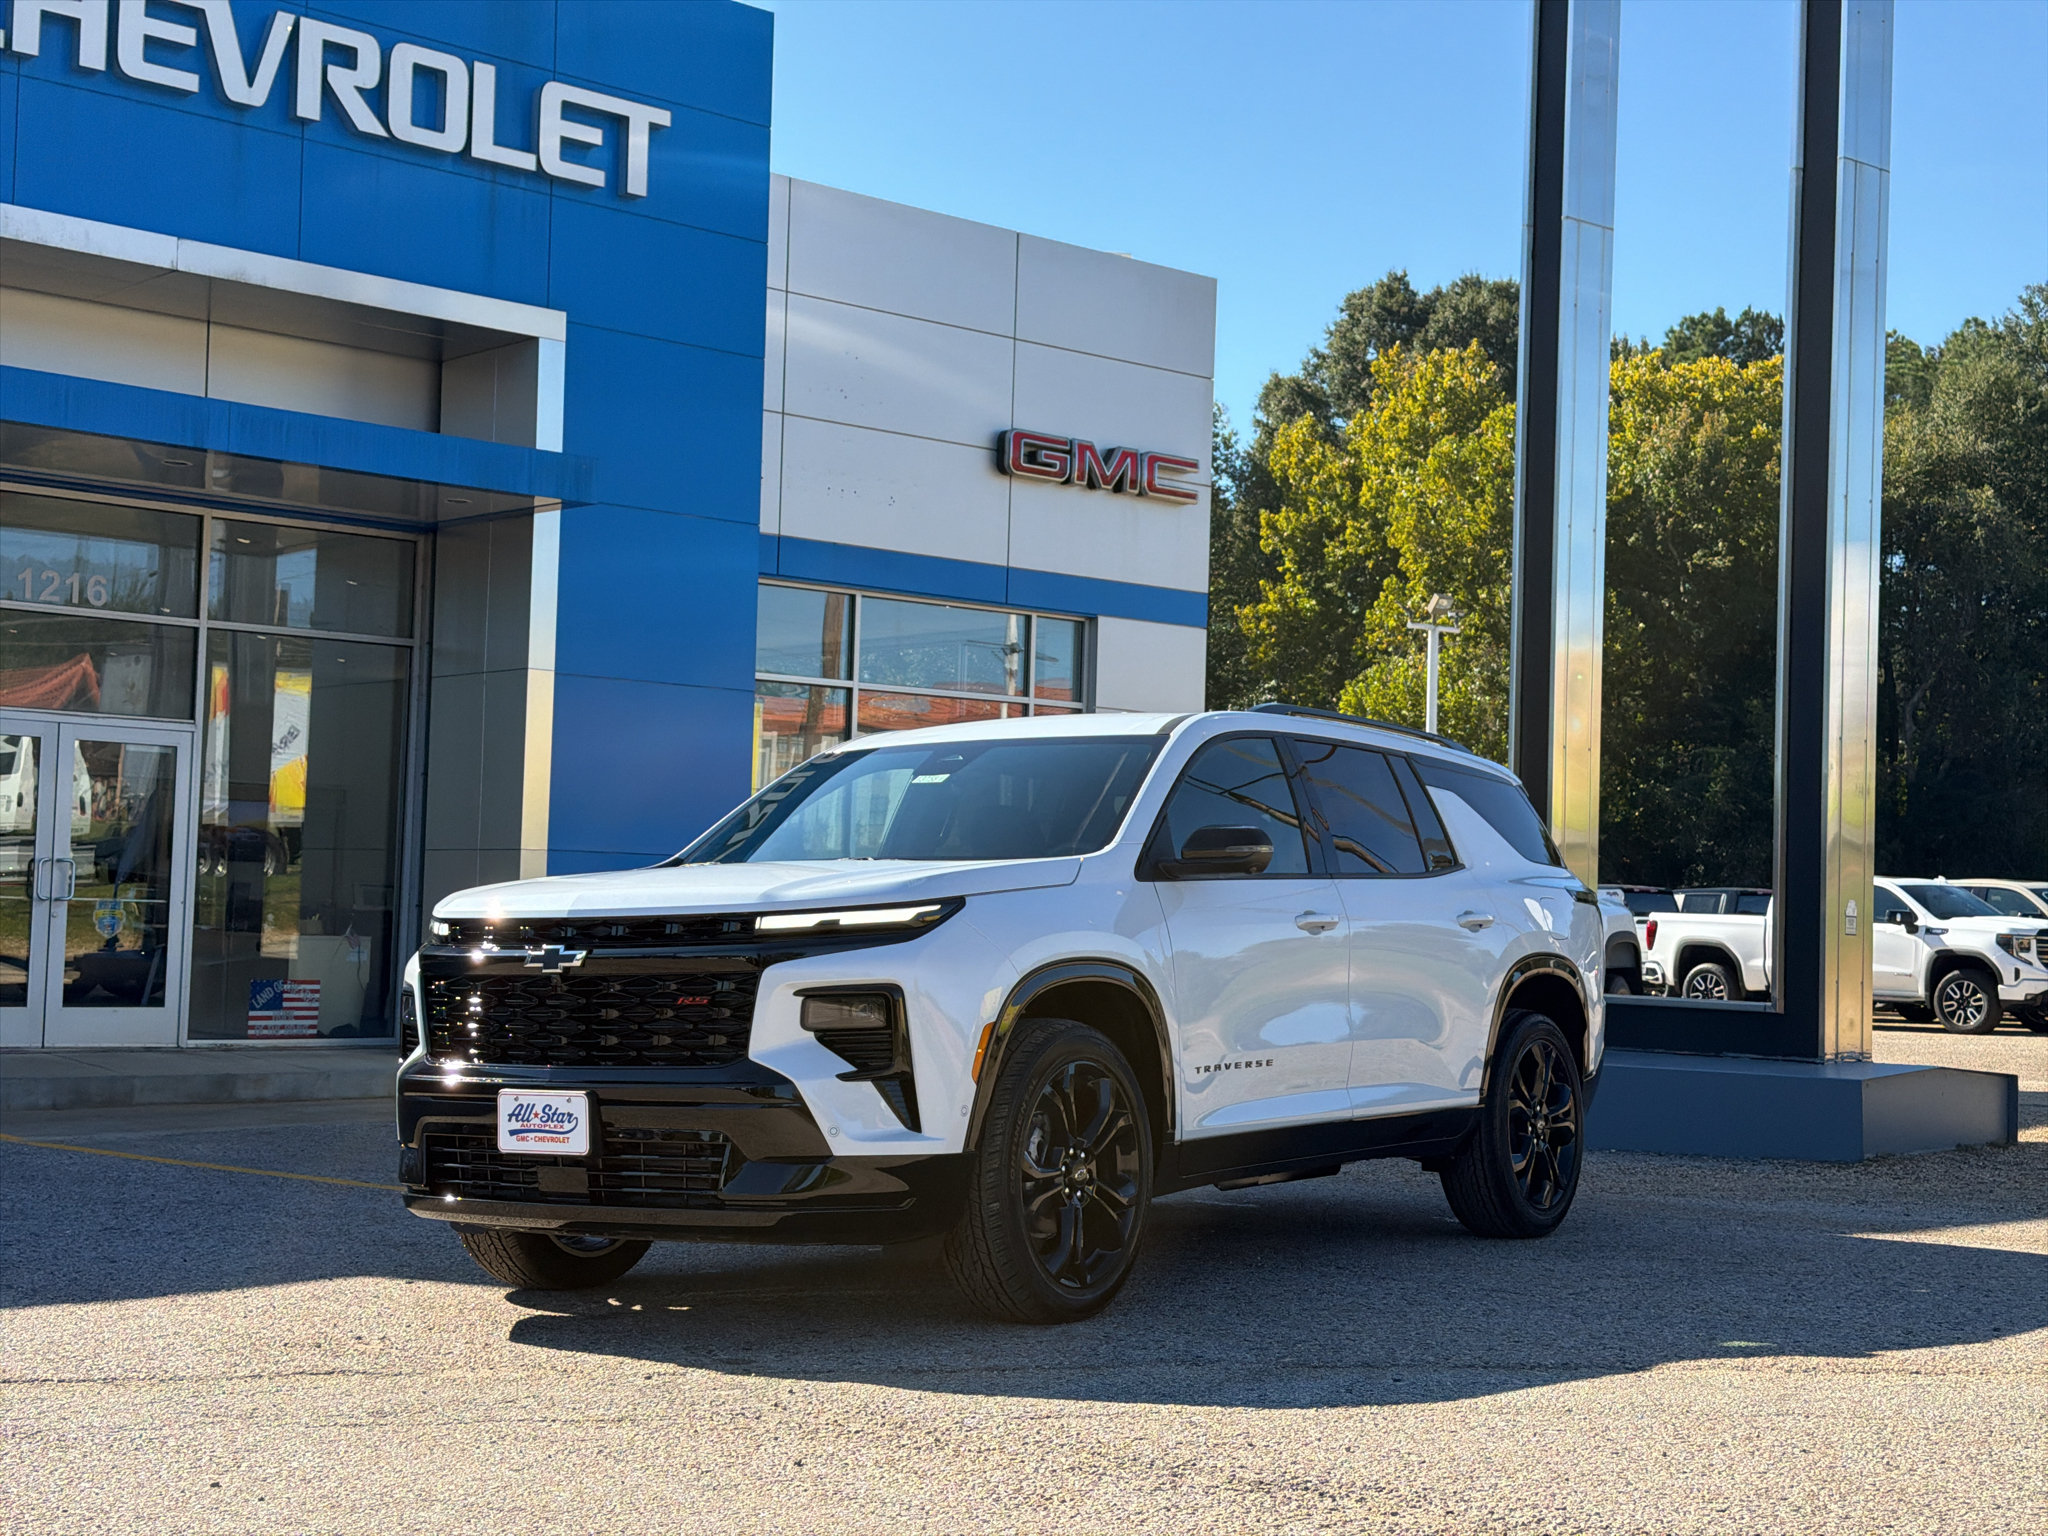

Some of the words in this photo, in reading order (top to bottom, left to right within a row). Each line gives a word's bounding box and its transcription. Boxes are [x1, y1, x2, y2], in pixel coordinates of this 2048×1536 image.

[0, 0, 671, 197] HEVROLET
[1000, 428, 1199, 504] GMC
[18, 567, 107, 607] 1216
[251, 986, 275, 1009] LAND
[677, 996, 710, 1005] RS
[1194, 1058, 1274, 1075] TRAVERSE
[507, 1103, 536, 1123] All
[540, 1104, 577, 1124] Star
[515, 1135, 530, 1143] GMC
[533, 1136, 571, 1144] CHEVROLET
